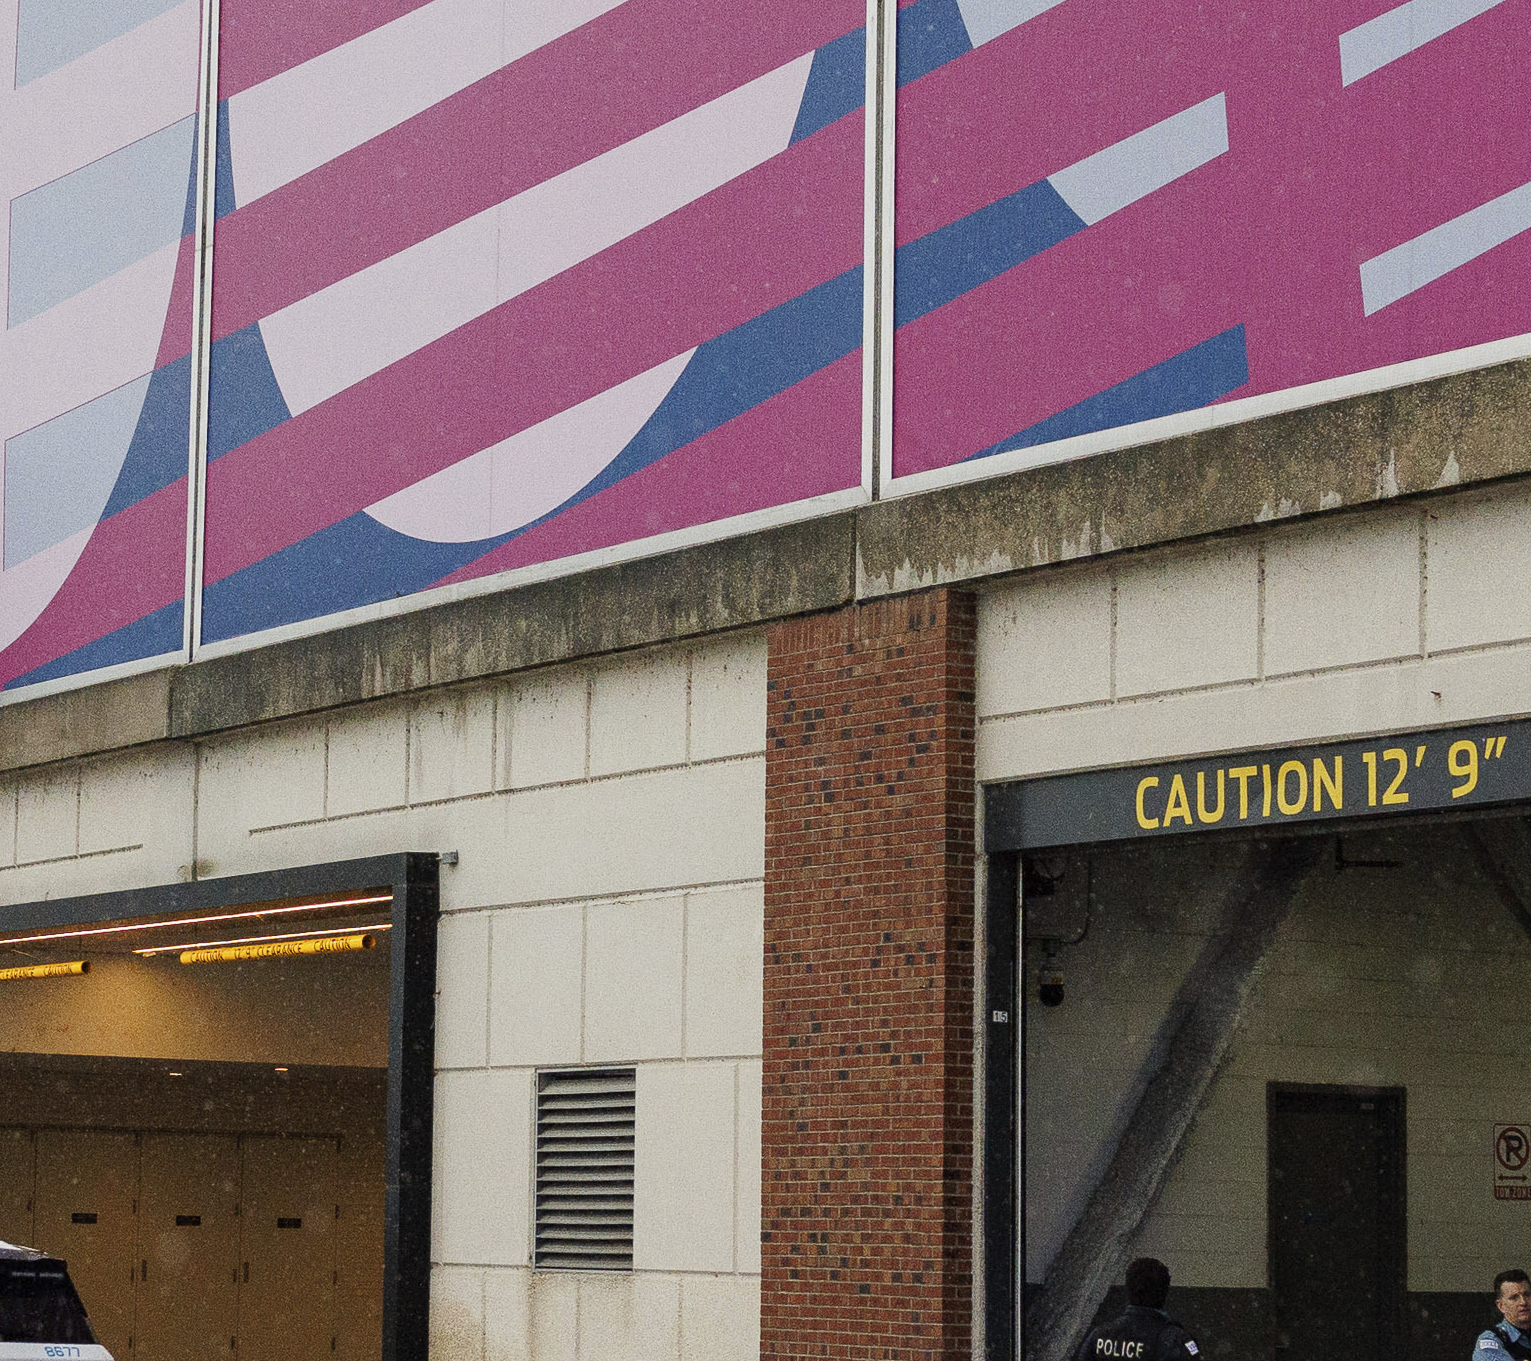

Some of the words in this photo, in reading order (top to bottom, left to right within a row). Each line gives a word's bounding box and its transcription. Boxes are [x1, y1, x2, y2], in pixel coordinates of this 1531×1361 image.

[1135, 756, 1346, 830] CAUTION
[44, 1346, 81, 1358] 8677
[1096, 1338, 1144, 1358] POLICE
